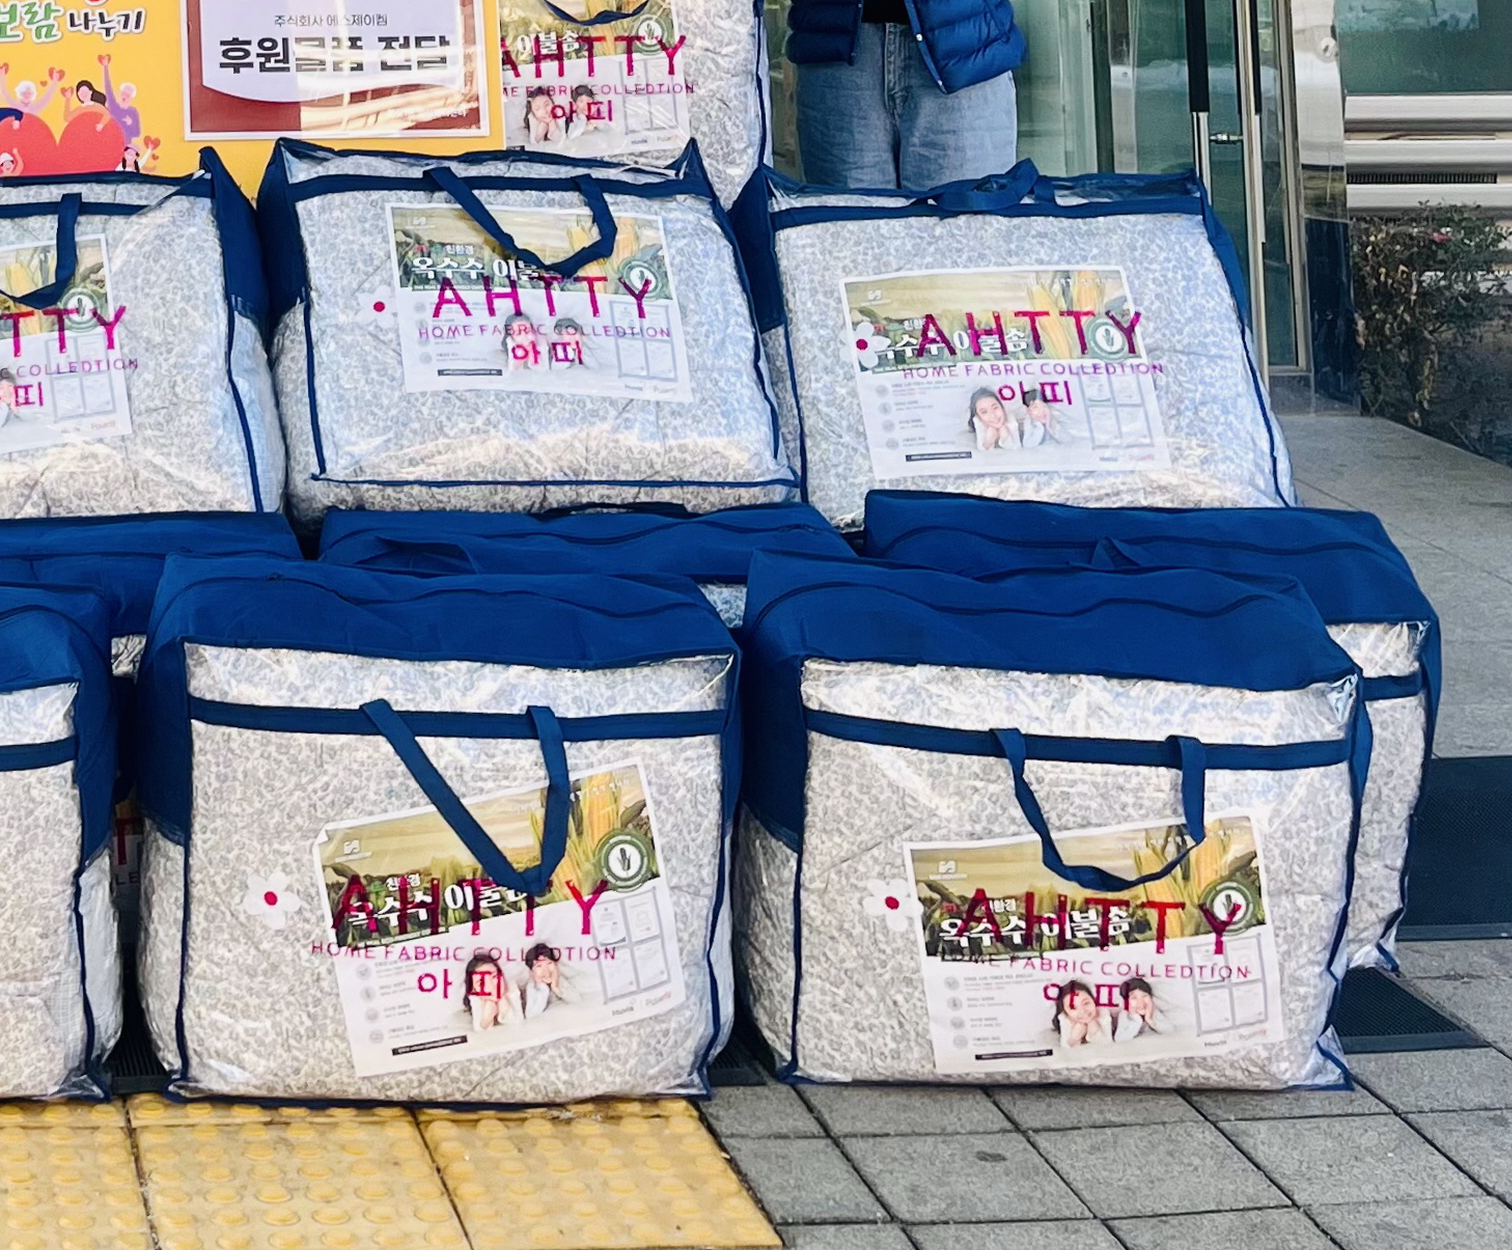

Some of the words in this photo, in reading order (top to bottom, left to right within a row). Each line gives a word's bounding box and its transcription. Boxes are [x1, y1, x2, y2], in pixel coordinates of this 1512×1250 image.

[68, 10, 144, 38] 나누기
[274, 13, 324, 28] 주식회사
[550, 100, 613, 122] 아띠
[411, 257, 486, 281] 옥수수
[432, 275, 652, 319] AHTTY
[418, 325, 474, 339] HOME
[478, 323, 548, 337] FABRIC
[916, 310, 1143, 358] AHTTY
[511, 340, 583, 365] 아띠
[902, 364, 958, 379] HOME
[965, 363, 1035, 376] FABRIC
[997, 380, 1073, 406] 아띠
[956, 887, 1242, 956] AHTTY
[384, 946, 464, 962] FABRIC
[417, 968, 503, 1000] 아띠
[1043, 982, 1130, 1011] 아띠
